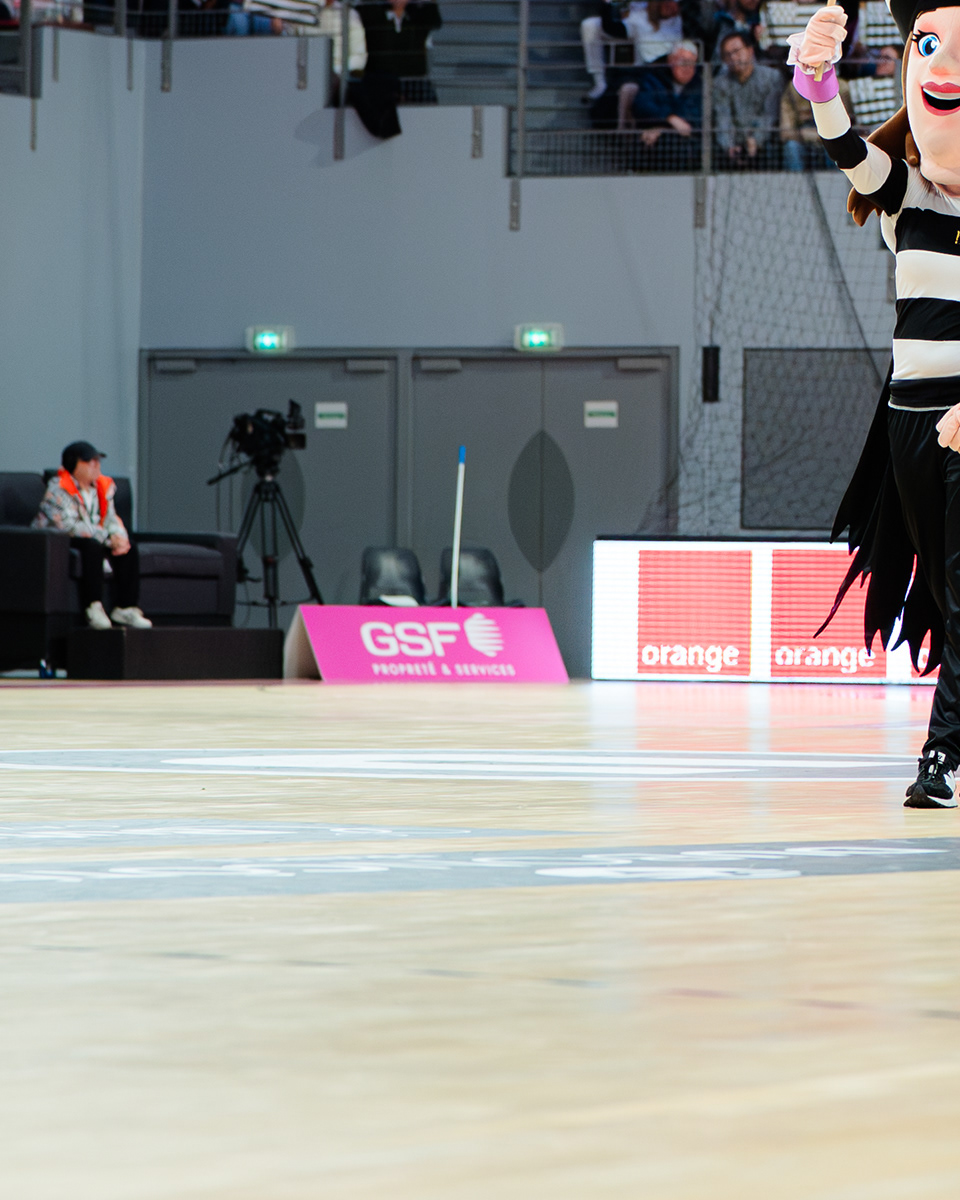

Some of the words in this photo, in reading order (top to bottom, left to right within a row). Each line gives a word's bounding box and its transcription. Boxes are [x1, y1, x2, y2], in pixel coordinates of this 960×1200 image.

[360, 622, 461, 657] GSF
[455, 663, 516, 677] SERVICES
[642, 644, 740, 673] orange
[774, 645, 877, 674] orange
